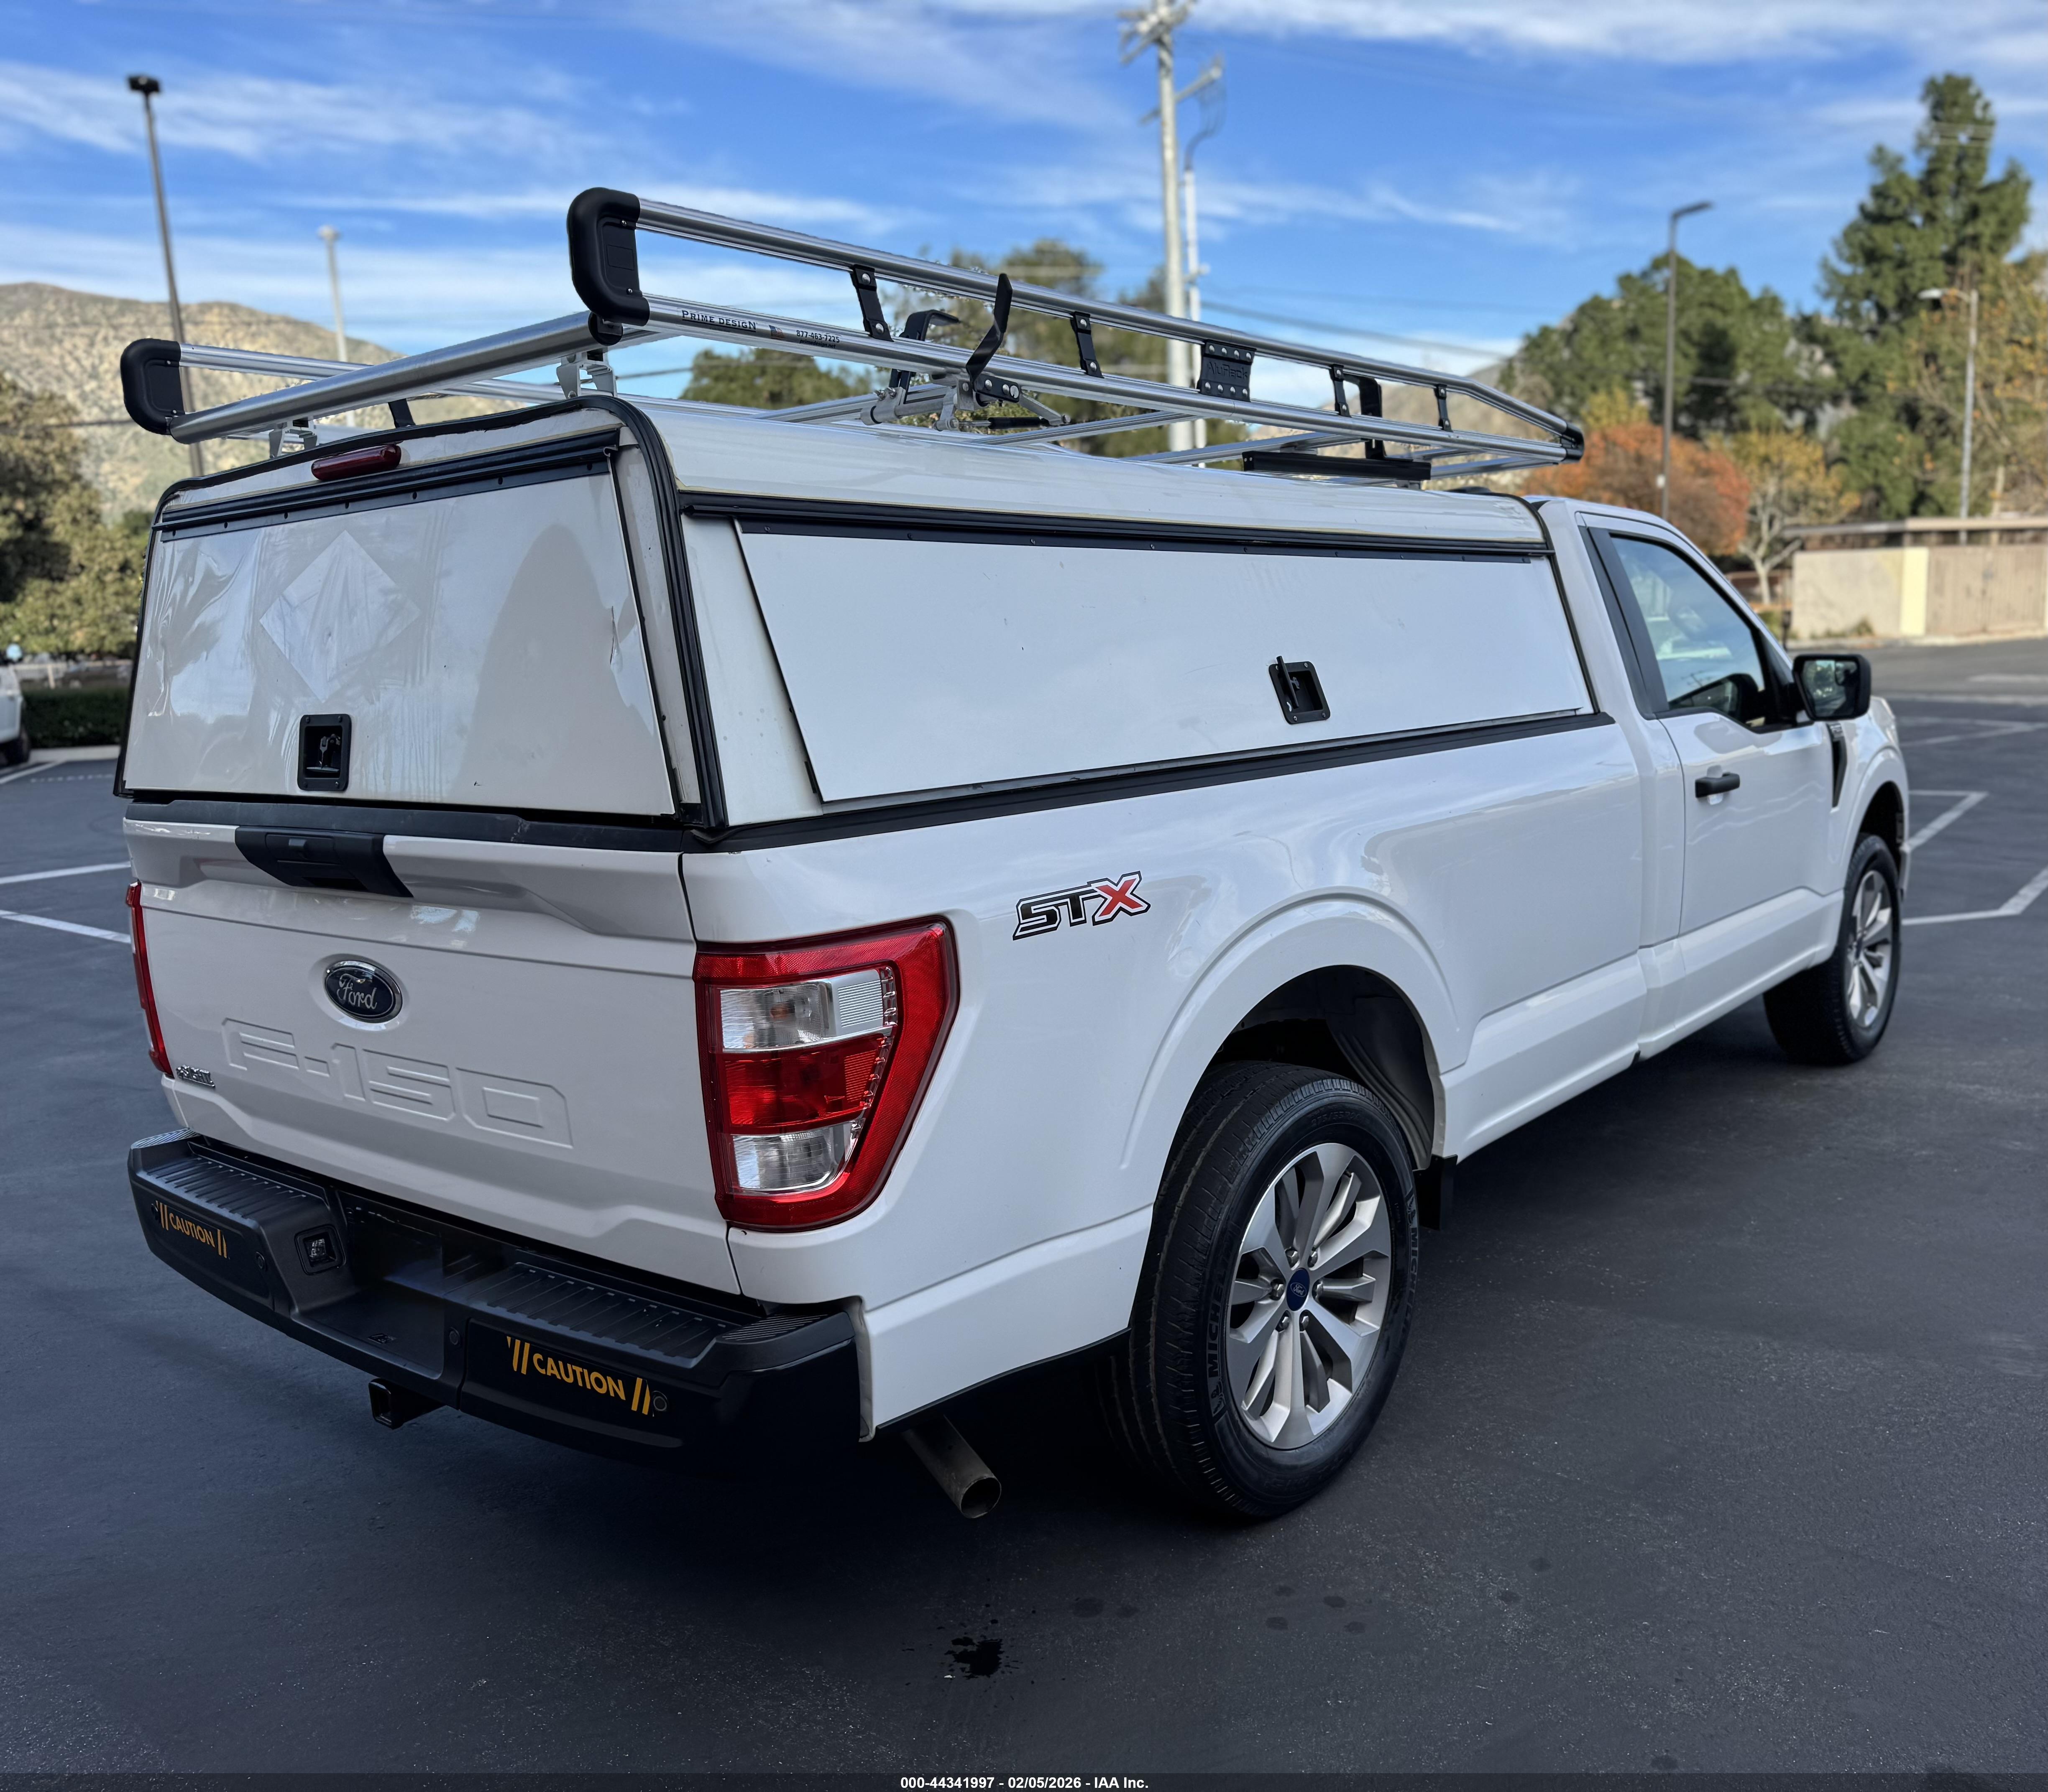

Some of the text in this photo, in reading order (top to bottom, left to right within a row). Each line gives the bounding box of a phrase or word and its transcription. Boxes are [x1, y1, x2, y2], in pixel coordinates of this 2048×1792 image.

[682, 310, 757, 330] PRIME DESIGN
[796, 330, 840, 343] 877-463-7225
[1012, 870, 1151, 941] STX
[336, 973, 377, 1009] Ford
[222, 1017, 574, 1149] F-150
[169, 1213, 216, 1248] CAUTION
[1207, 1232, 1236, 1378] MICHEL
[1293, 1284, 1305, 1295] Ford
[532, 1353, 626, 1401] CAUTION
